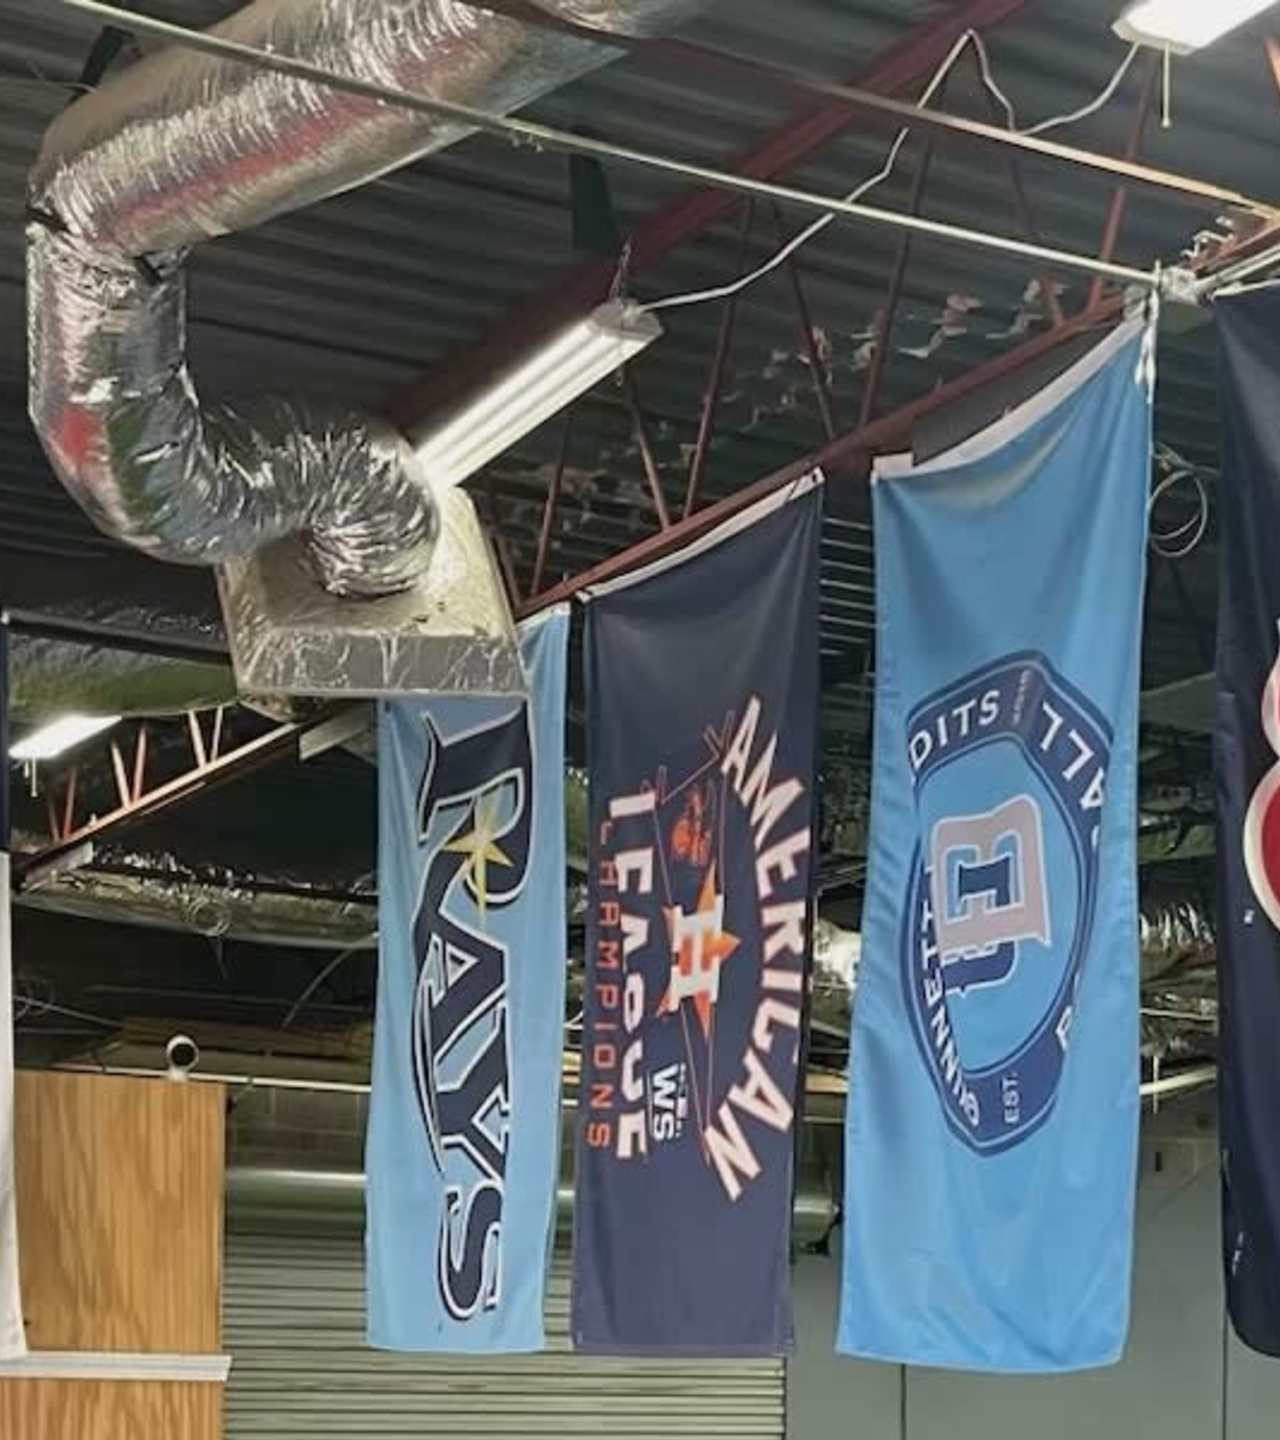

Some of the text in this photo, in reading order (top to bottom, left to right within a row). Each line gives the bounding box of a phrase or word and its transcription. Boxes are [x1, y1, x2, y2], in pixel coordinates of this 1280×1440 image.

[411, 697, 536, 1321] RAYS
[652, 1063, 679, 1141] WS
[704, 696, 810, 1202] AMERICAN
